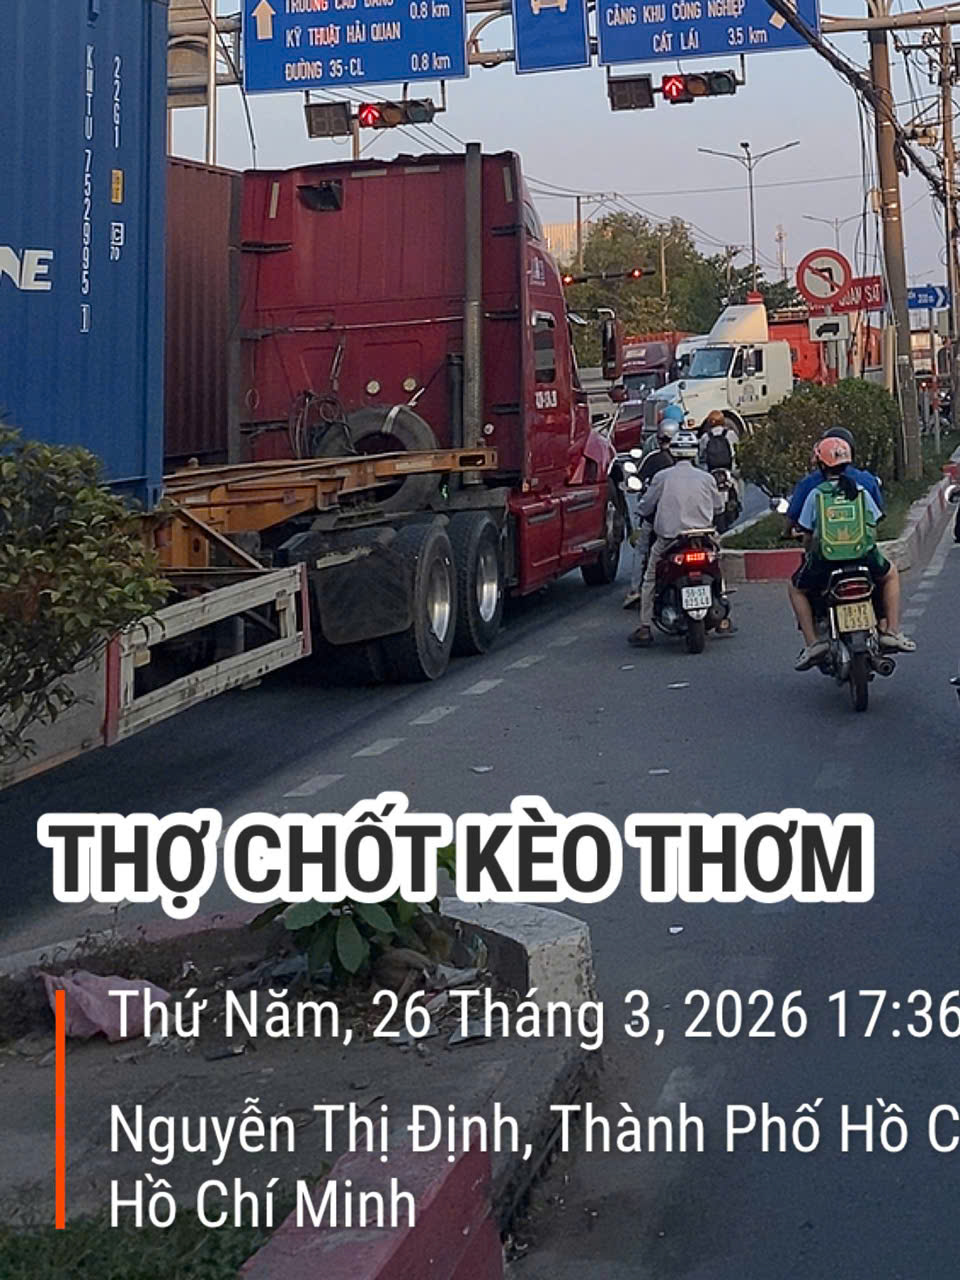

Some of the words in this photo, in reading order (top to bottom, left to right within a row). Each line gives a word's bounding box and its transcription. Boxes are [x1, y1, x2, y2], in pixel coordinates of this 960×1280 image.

[409, 2, 428, 19] 0.8
[431, 1, 450, 18] km
[643, 4, 666, 23] KHU
[672, 0, 701, 21] CÔNG
[307, 25, 341, 48] THUẬT
[371, 21, 401, 41] QUAN
[652, 29, 673, 53] CÁT
[681, 27, 699, 50] LÁI
[749, 26, 768, 43] km
[285, 57, 323, 81] ĐƯỜNG
[411, 53, 429, 71] 0.8
[432, 52, 451, 69] km
